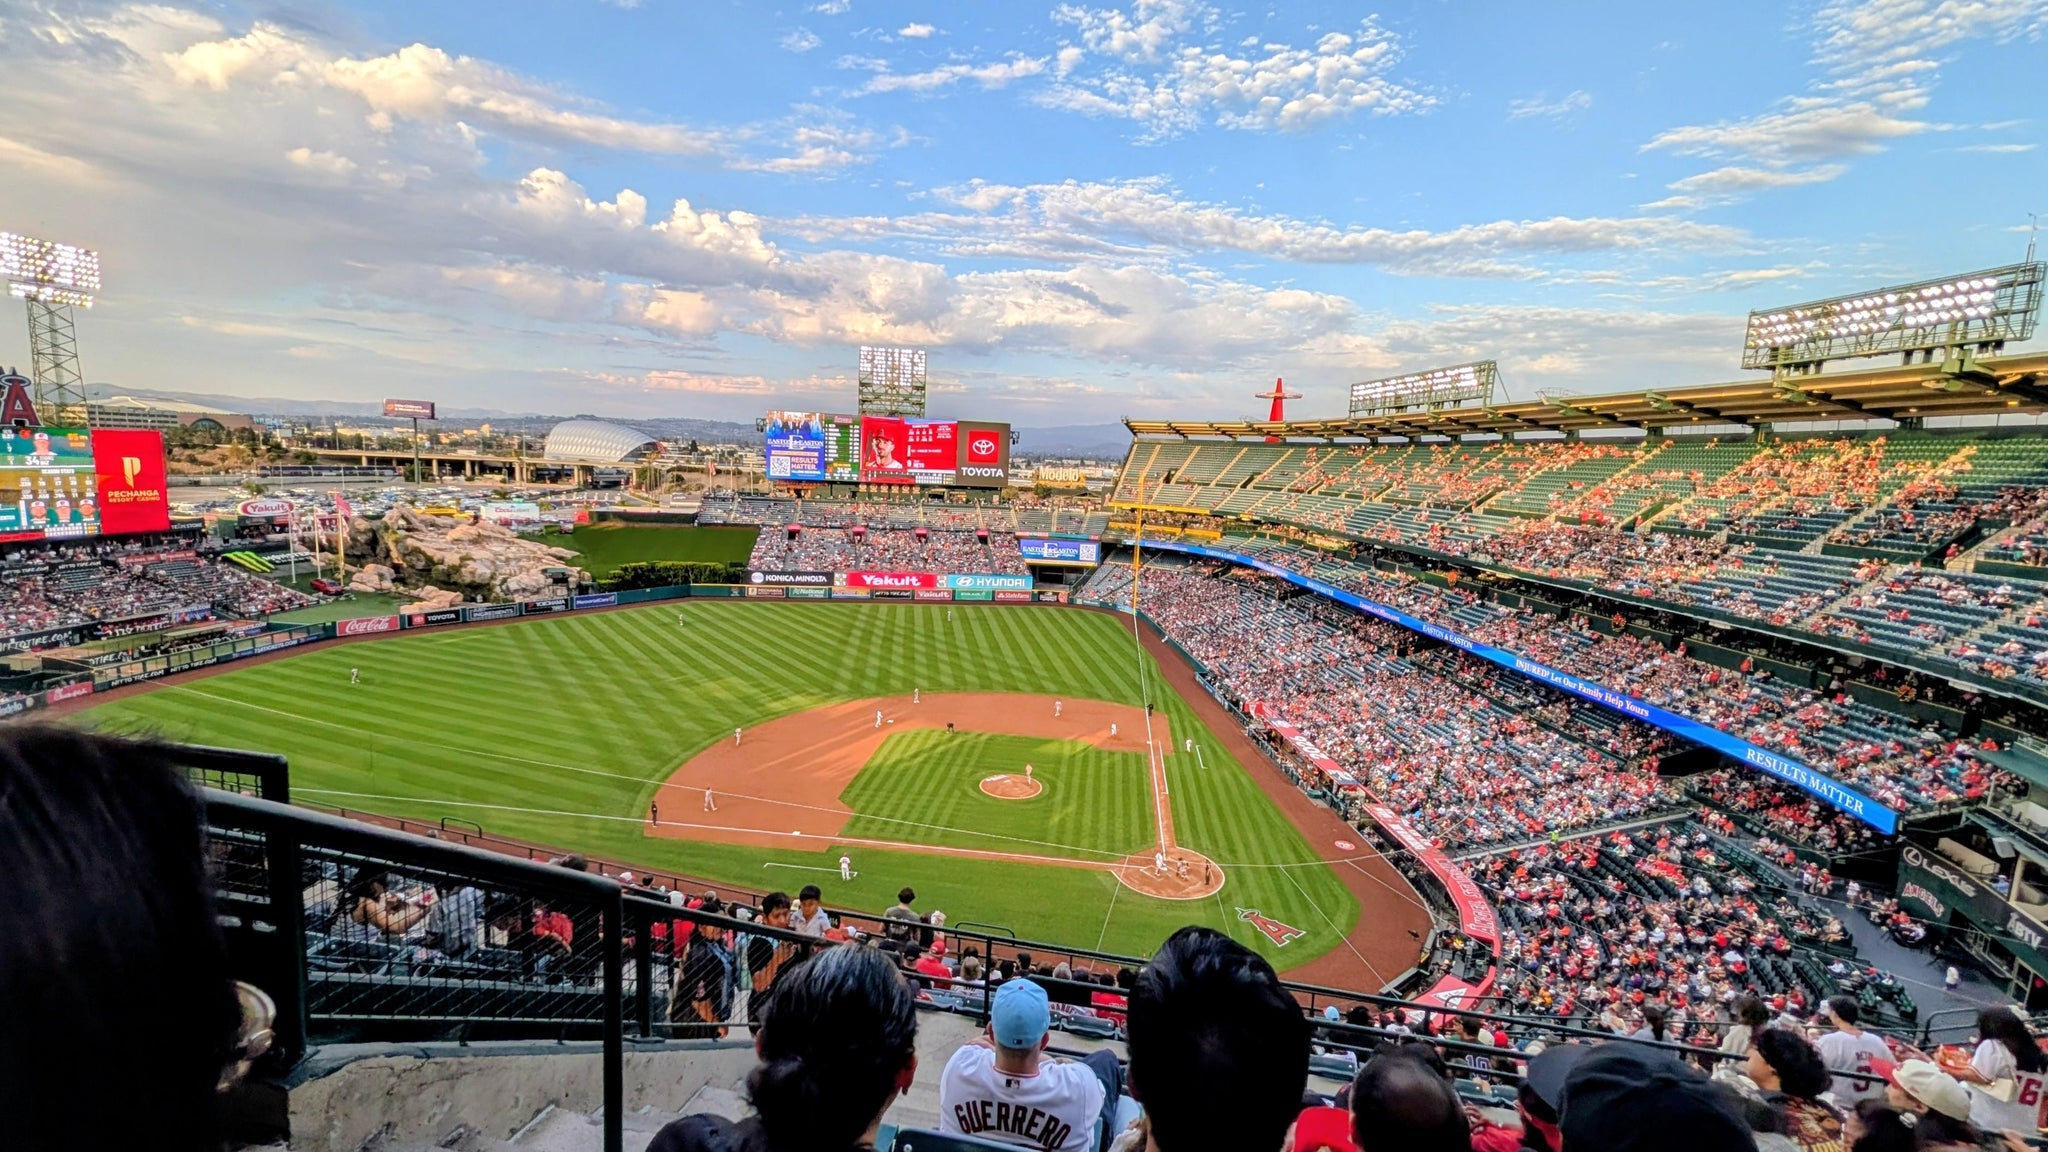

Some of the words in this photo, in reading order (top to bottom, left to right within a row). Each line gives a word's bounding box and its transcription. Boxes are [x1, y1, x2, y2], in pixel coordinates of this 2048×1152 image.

[961, 466, 1004, 478] TOYOTA
[1039, 465, 1079, 481] Modelo
[108, 489, 160, 498] PECHANGA
[250, 503, 287, 513] Yakult
[765, 574, 794, 582] KONICA
[795, 575, 828, 583] MINOLTA
[861, 574, 921, 586] Yakult
[976, 577, 1025, 587] HYUNDAI
[918, 590, 950, 598] Yakult
[427, 613, 456, 621] TOYOTA
[1422, 623, 1444, 639] EASTON
[1449, 634, 1473, 650] EASTON
[169, 663, 190, 673] NITTO
[190, 657, 218, 669] TIRE.COM
[111, 677, 133, 687] NITTO
[134, 669, 165, 682] TIRE.COM
[1515, 659, 1550, 678] INJURED?
[1550, 672, 1562, 683] Let
[1563, 677, 1577, 689] Our
[1577, 682, 1606, 701] Family
[1604, 692, 1624, 707] Help
[1624, 700, 1650, 717] Yours
[1746, 747, 1808, 784] RESULTS
[1808, 775, 1864, 815] MATTER
[1922, 858, 1977, 898] LEXUS
[1901, 881, 1945, 918] ANGELS
[954, 1100, 1072, 1150] GUERRERO
